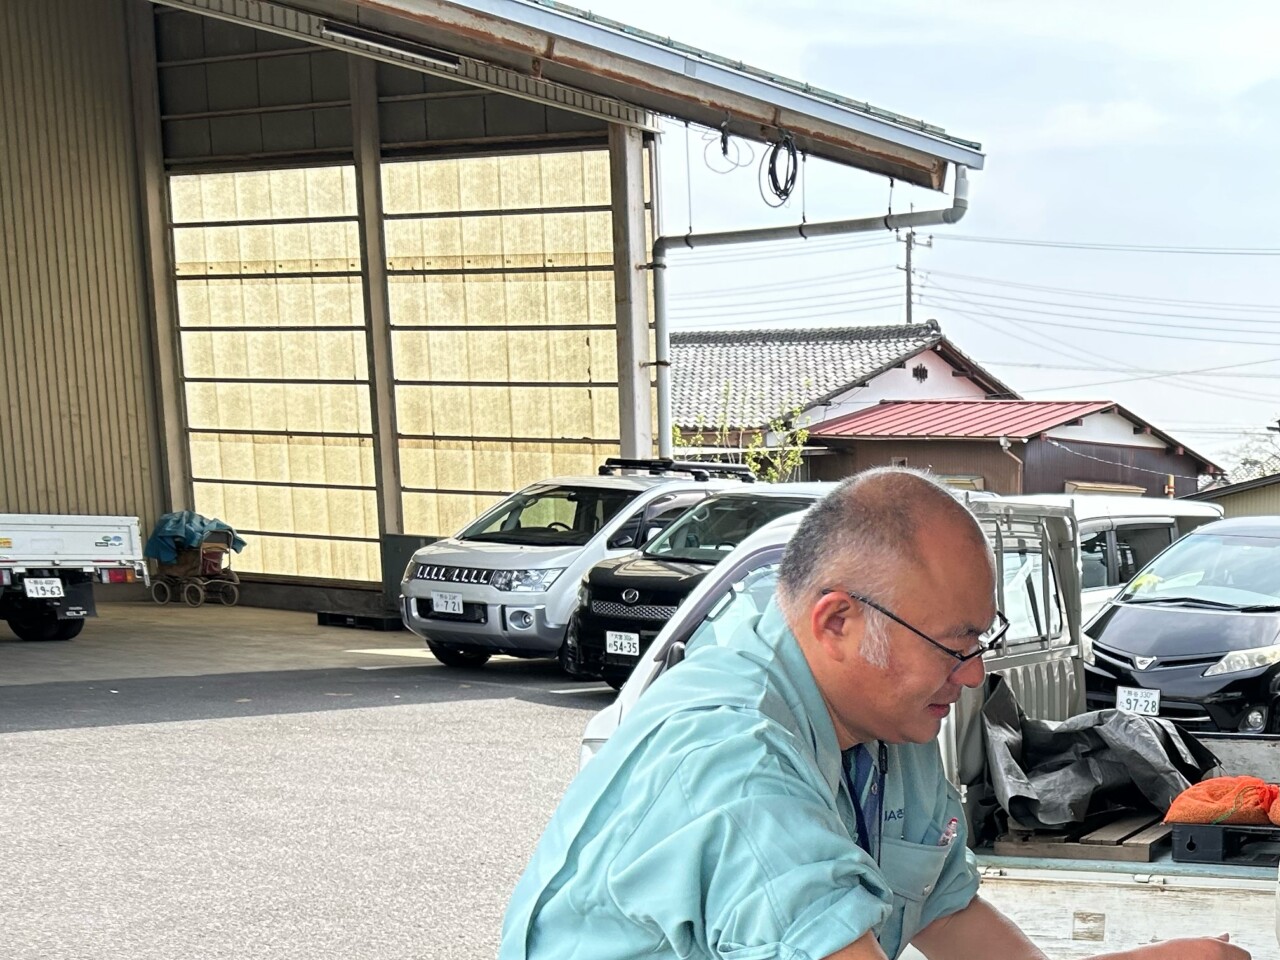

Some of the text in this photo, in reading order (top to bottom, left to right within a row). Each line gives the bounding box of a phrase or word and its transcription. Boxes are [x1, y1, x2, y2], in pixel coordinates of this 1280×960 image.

[35, 586, 61, 596] 19-63
[613, 641, 637, 653] 54-35
[1125, 698, 1157, 713] 97-28
